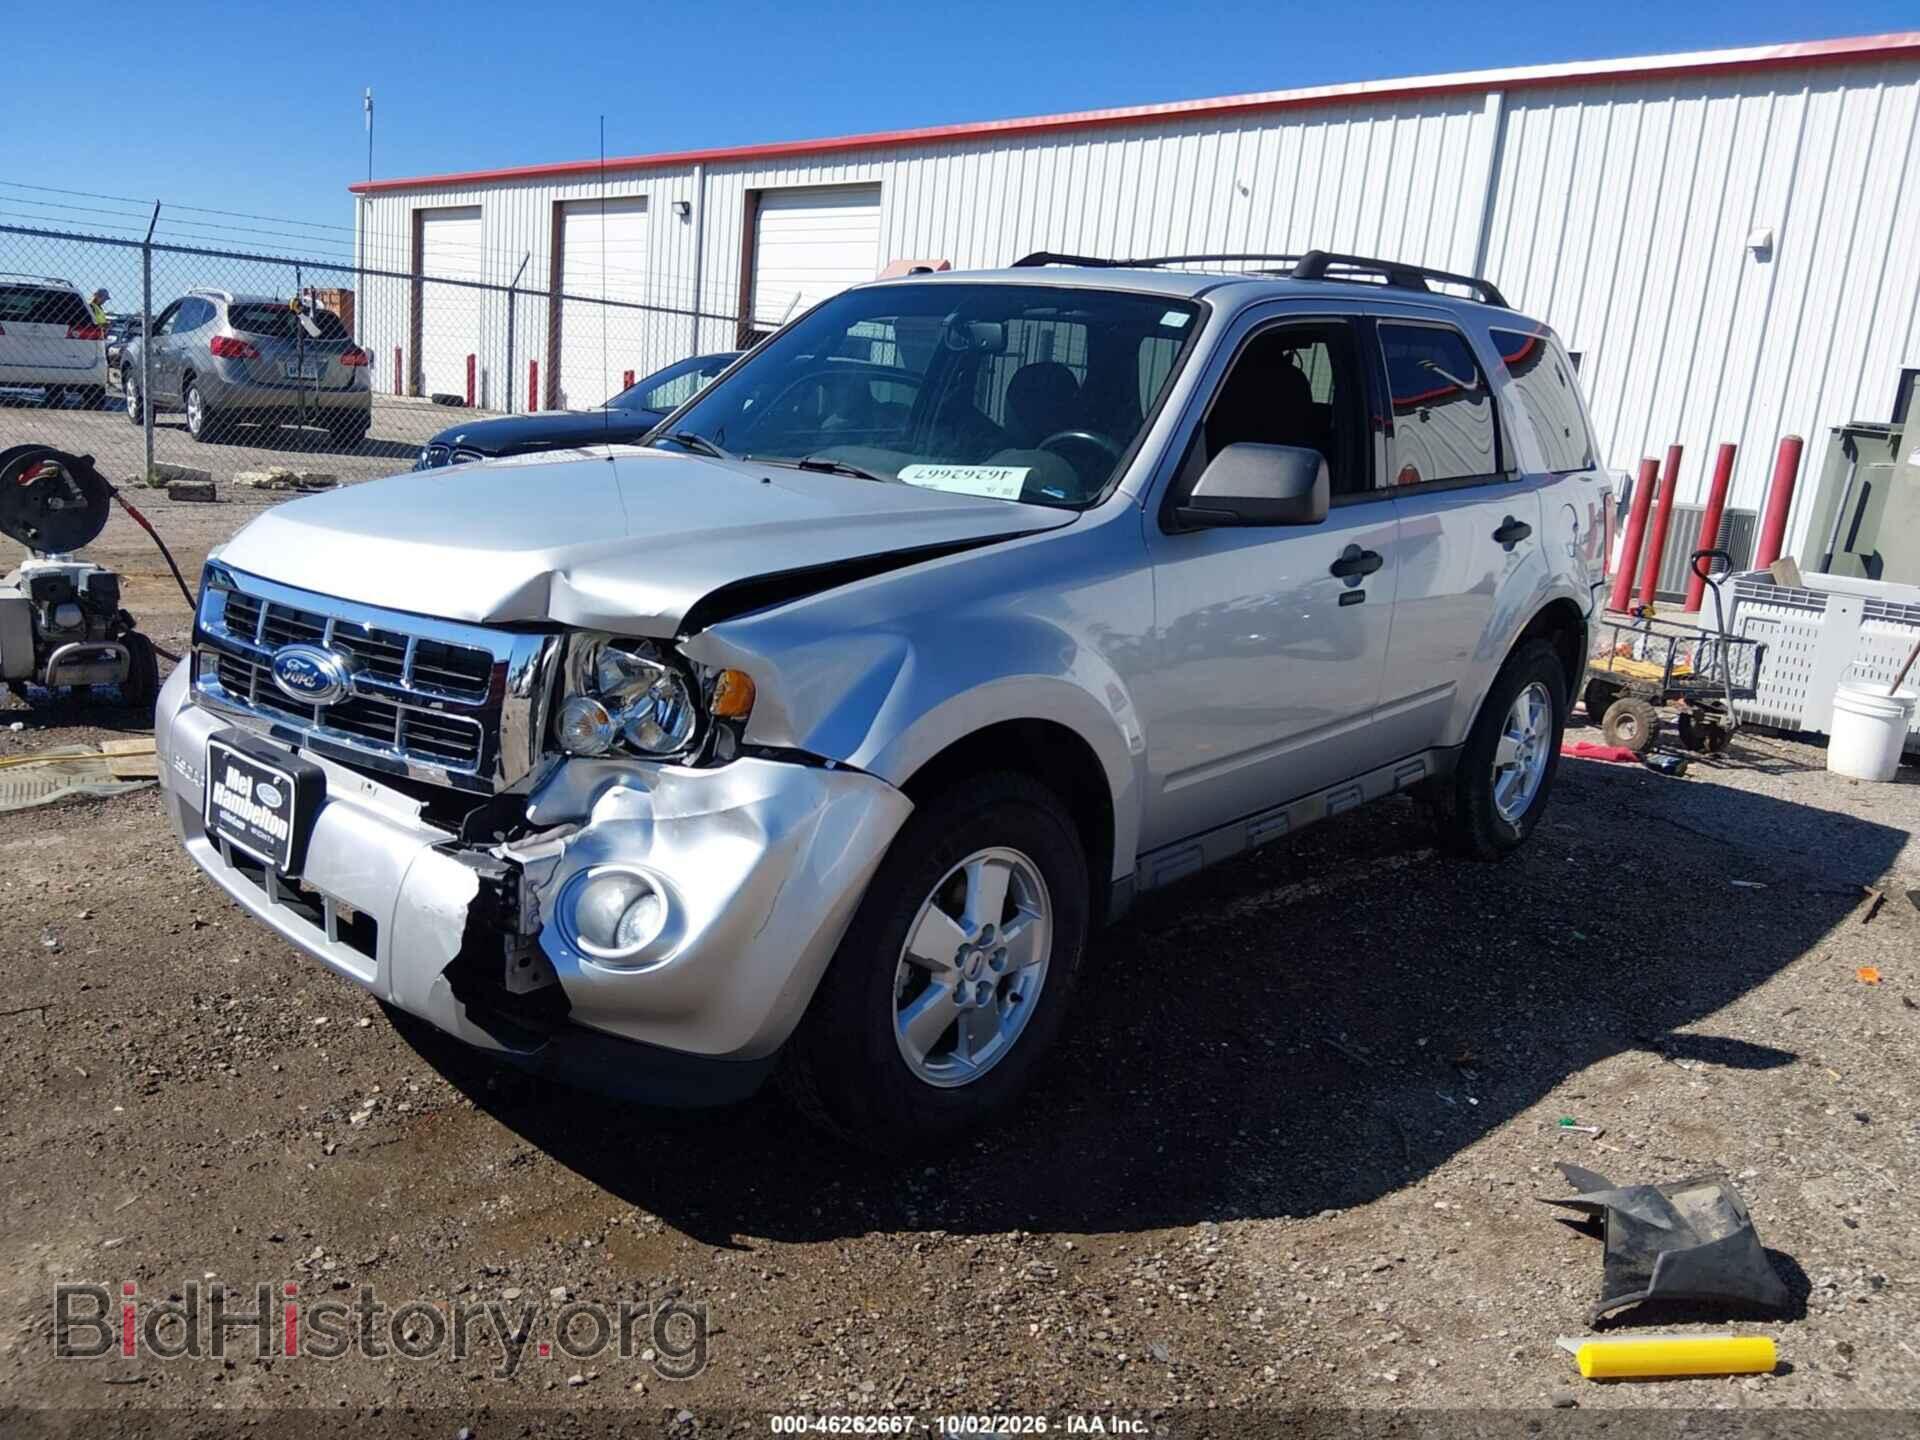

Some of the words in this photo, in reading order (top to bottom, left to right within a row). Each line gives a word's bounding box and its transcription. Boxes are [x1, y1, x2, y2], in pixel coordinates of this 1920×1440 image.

[913, 469, 1013, 481] 46262667
[282, 658, 319, 688] Ford
[224, 765, 253, 797] Mel
[212, 781, 289, 841] Hambelton
